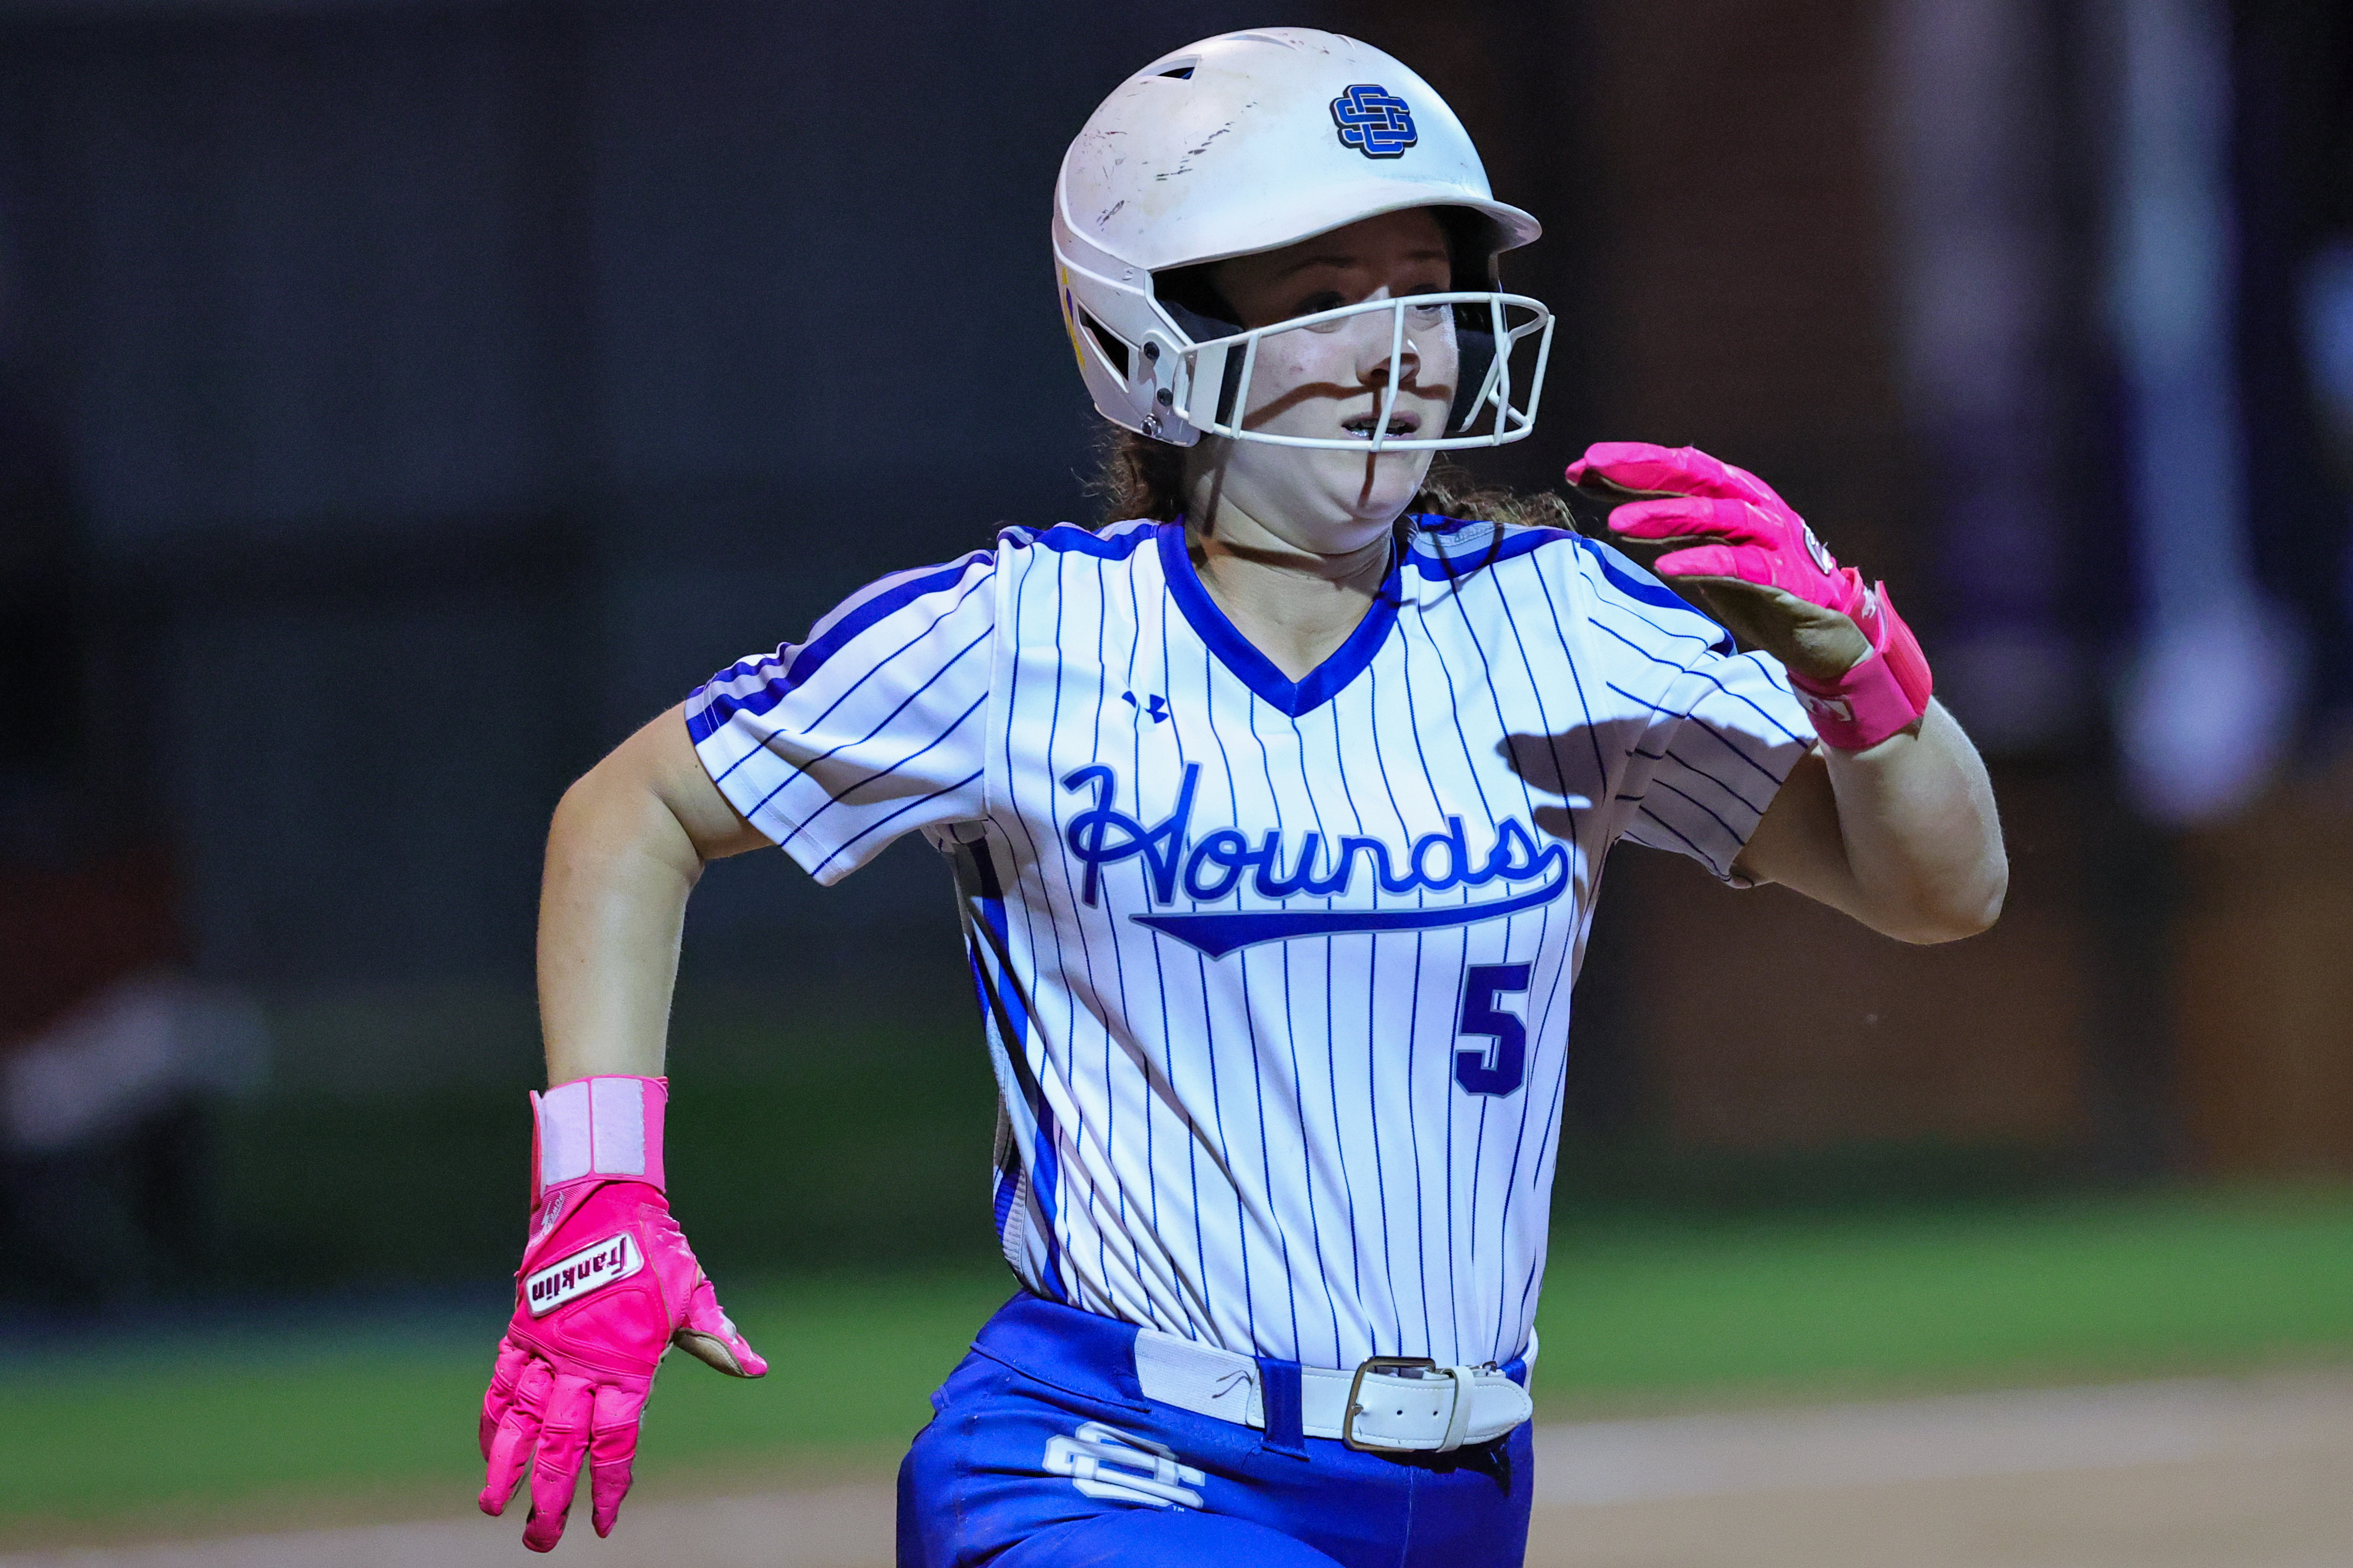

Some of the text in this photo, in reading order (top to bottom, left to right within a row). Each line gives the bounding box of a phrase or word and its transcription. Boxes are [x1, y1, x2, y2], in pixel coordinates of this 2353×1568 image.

[1060, 761, 1568, 908] Hounds
[1453, 961, 1533, 1099] 5
[532, 1236, 627, 1302] Franklin
